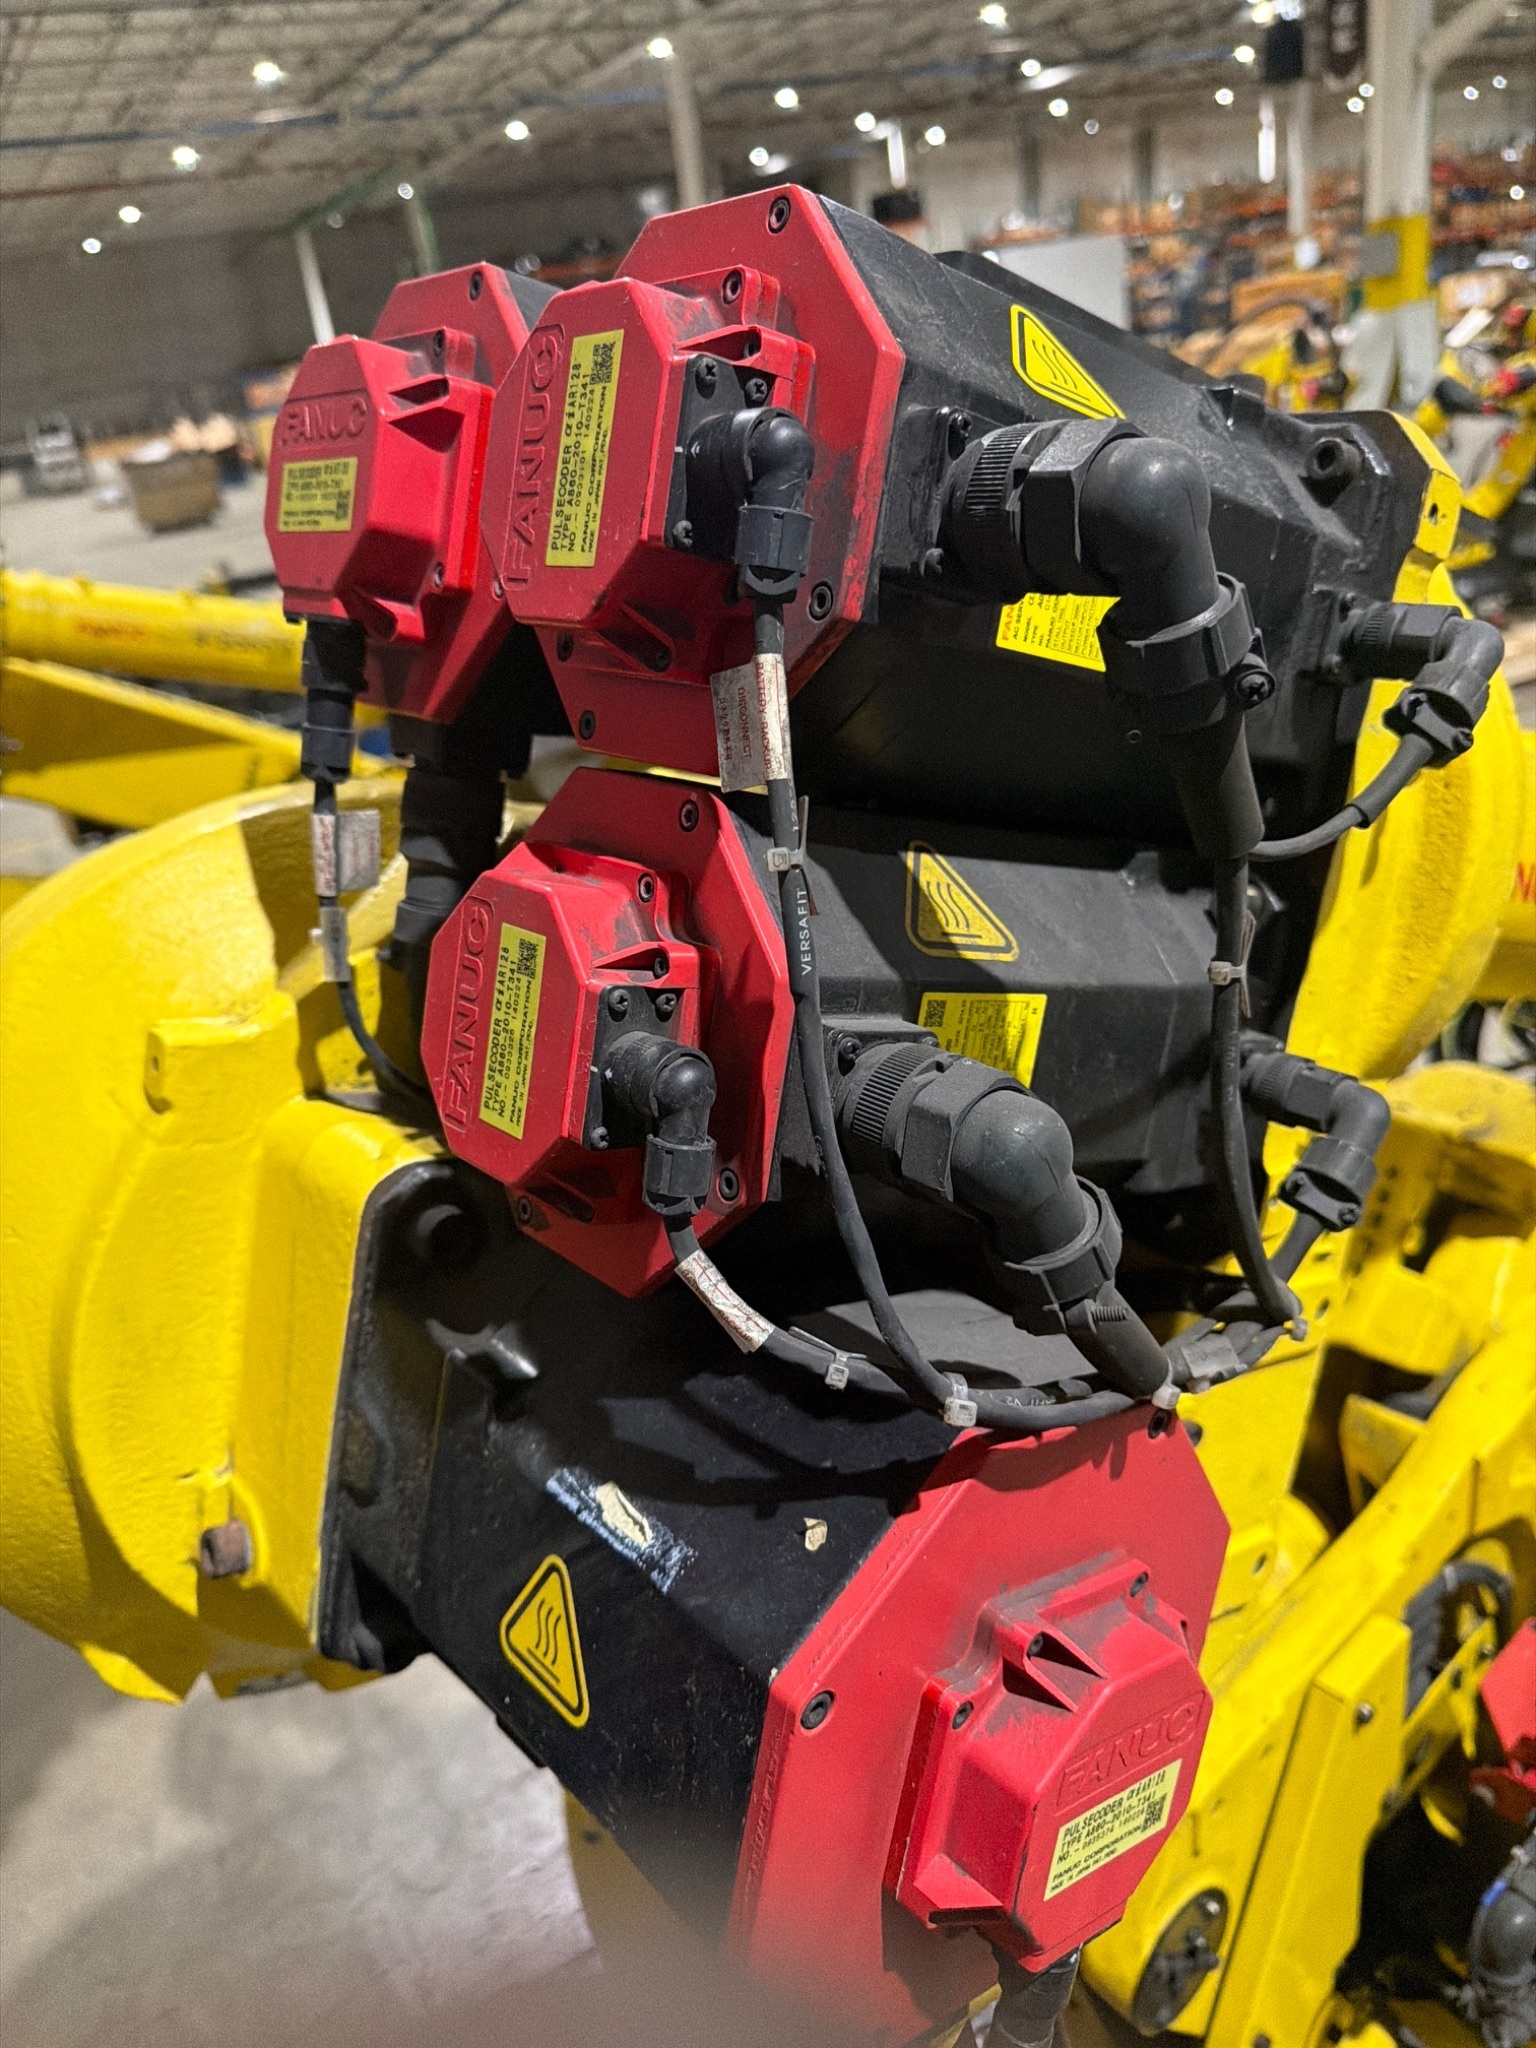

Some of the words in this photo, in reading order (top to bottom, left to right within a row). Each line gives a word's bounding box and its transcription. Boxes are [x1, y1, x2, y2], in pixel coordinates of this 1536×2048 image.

[282, 397, 367, 446] FANUC
[582, 388, 595, 437] 140224
[506, 334, 558, 584] FANUC
[560, 513, 572, 550] TYPE
[566, 373, 590, 506] A860-2010-T341
[579, 502, 592, 552] FANUC
[587, 385, 607, 495] CORPORATION
[551, 445, 572, 550] PULSECODER
[591, 512, 597, 521] IN
[593, 479, 601, 506] JAPAN
[587, 529, 595, 552] MADE
[1012, 626, 1019, 640] AC
[1015, 599, 1024, 624] SERV
[1022, 615, 1031, 642] MODEL
[1029, 625, 1038, 644] TYPE
[1045, 616, 1055, 648] FANUC
[1059, 619, 1070, 649] OUTPUT
[757, 661, 768, 714] BATTERY
[737, 687, 752, 759] DISCONNECT
[760, 721, 772, 770] BACKUP
[797, 887, 812, 976] VERSAFIT
[444, 906, 489, 1125] FANUC
[510, 976, 521, 1020] 140224
[492, 1079, 502, 1114] TYPE
[497, 960, 517, 1077] A860-2010-T341
[514, 978, 532, 1076] CORPORATION
[484, 1017, 502, 1111] PULSECODER
[509, 1078, 520, 1124] FANUC
[518, 1090, 524, 1101] IN
[1056, 1702, 1196, 1807] FANUC
[1059, 1830, 1083, 1854] TYPE
[1062, 1794, 1124, 1841] PULSECODER
[1052, 1858, 1082, 1883] FANUC
[1083, 1822, 1141, 1864] CORPORATION
